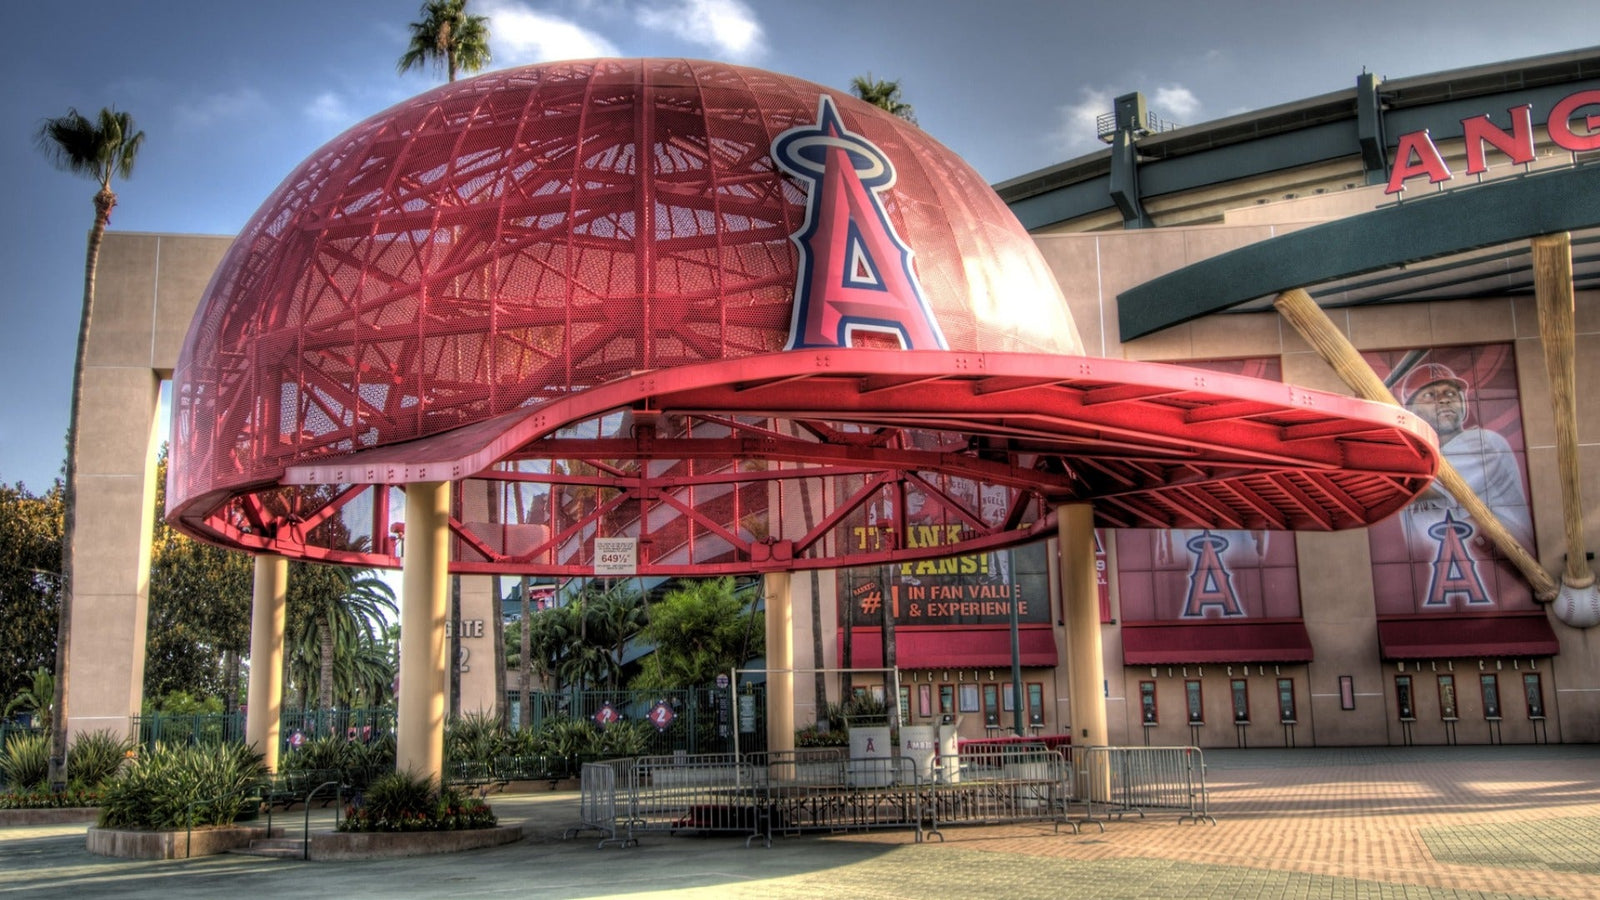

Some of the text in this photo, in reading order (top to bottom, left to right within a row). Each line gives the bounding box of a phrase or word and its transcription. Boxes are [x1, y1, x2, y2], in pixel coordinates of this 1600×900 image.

[770, 94, 949, 351] A
[854, 525, 962, 549] TNK
[908, 586, 926, 600] IN
[931, 585, 963, 599] FAN
[909, 601, 1028, 617] & EXPERIENE
[445, 620, 483, 638] GTE
[656, 707, 666, 722] 2
[294, 733, 302, 745] 2
